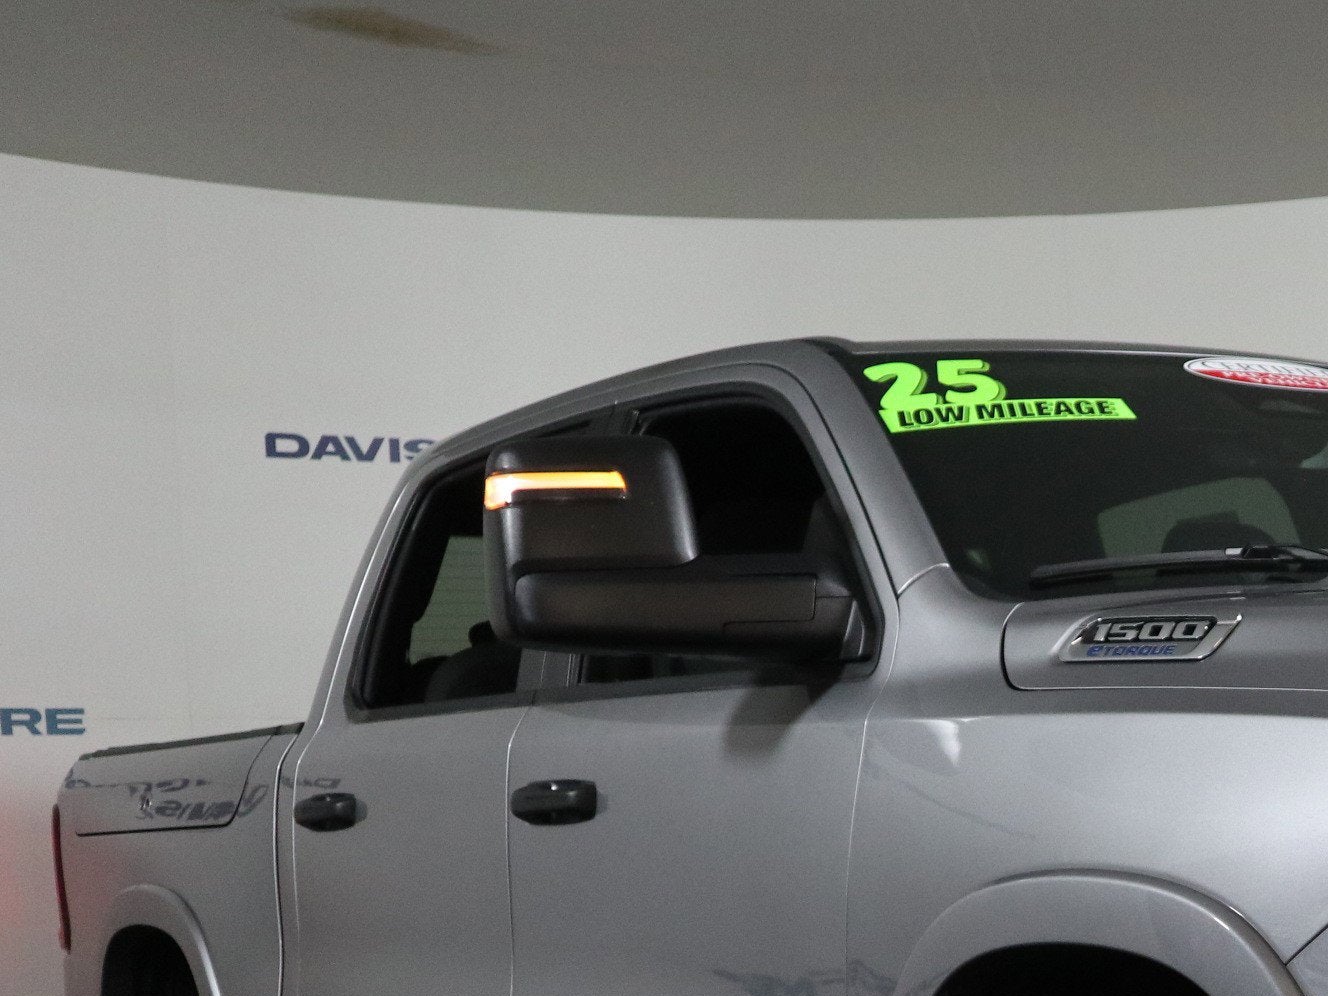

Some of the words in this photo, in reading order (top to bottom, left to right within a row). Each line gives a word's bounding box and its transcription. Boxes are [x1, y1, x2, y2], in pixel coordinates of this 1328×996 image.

[864, 359, 1005, 406] 25
[897, 409, 965, 426] LOW
[976, 401, 1114, 420] MILEAGE
[1094, 620, 1208, 642] 1500
